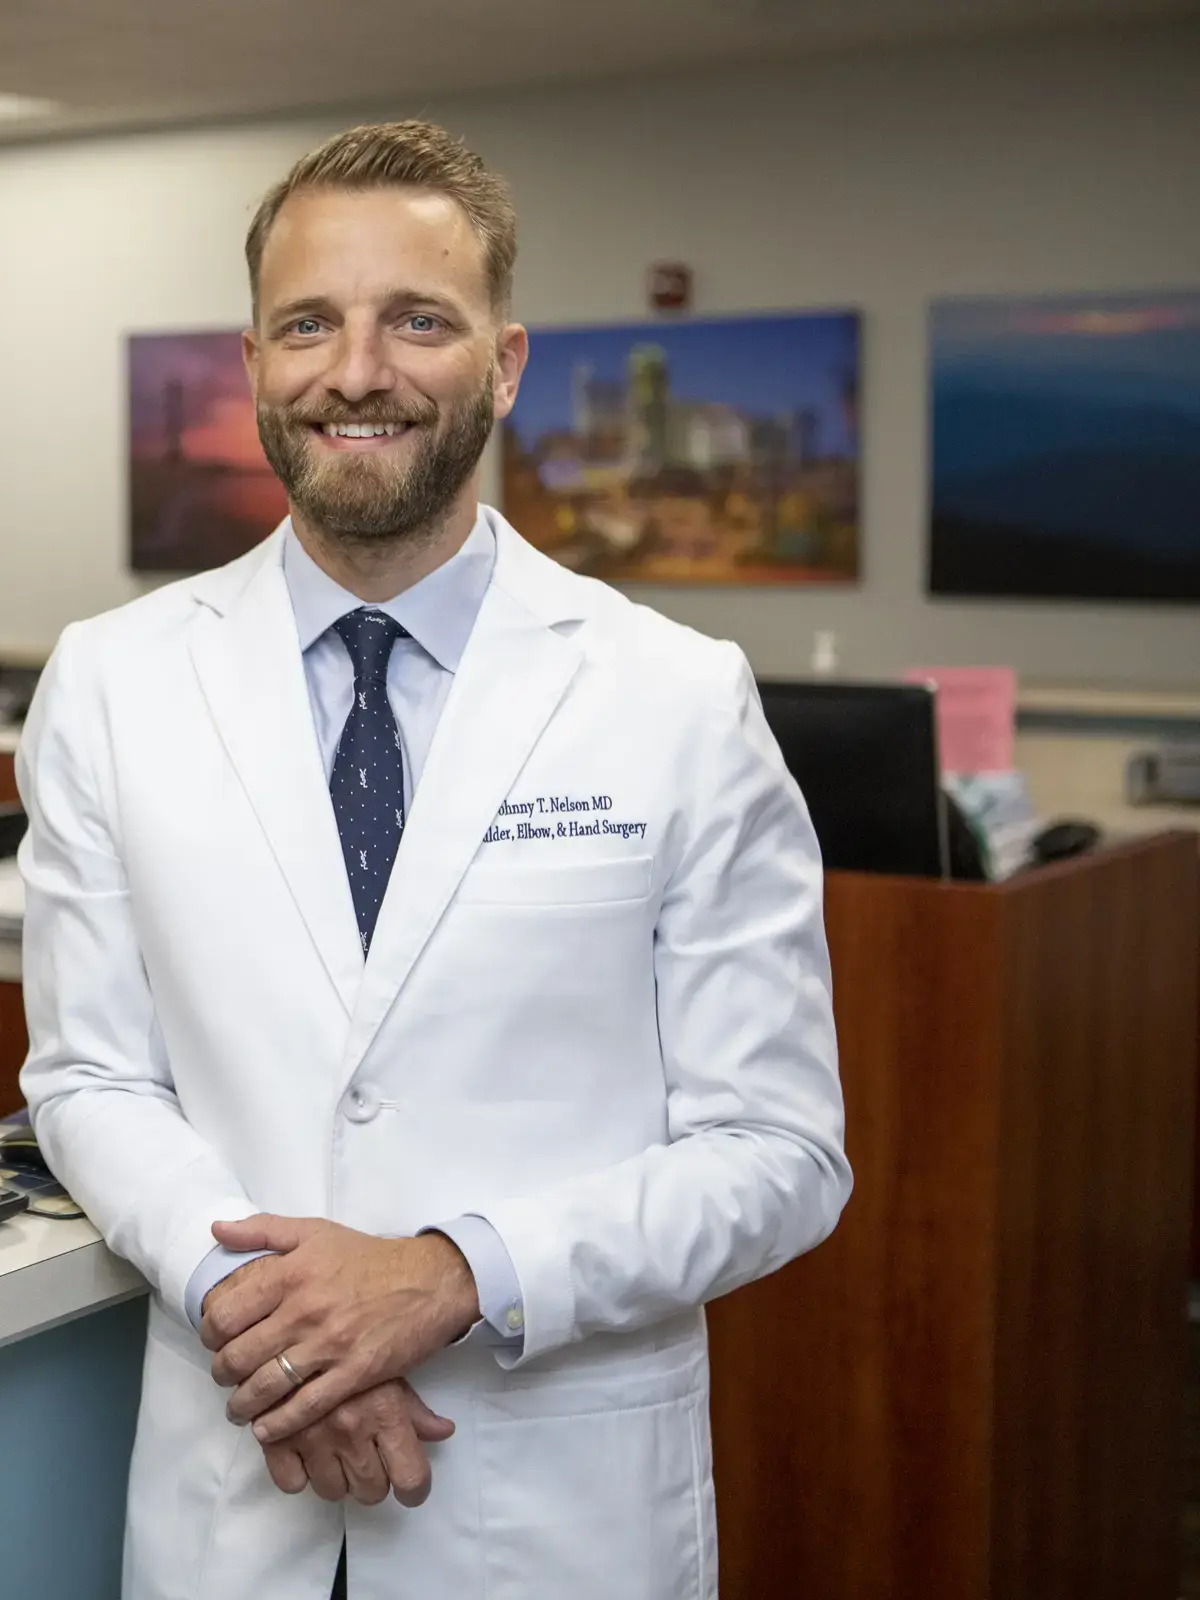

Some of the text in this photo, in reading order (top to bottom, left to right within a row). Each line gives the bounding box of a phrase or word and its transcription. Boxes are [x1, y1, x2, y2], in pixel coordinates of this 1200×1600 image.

[498, 795, 613, 818] ohnny T. Nelson MD
[482, 819, 647, 843] ulder, Elbow, & Hand Surgery
